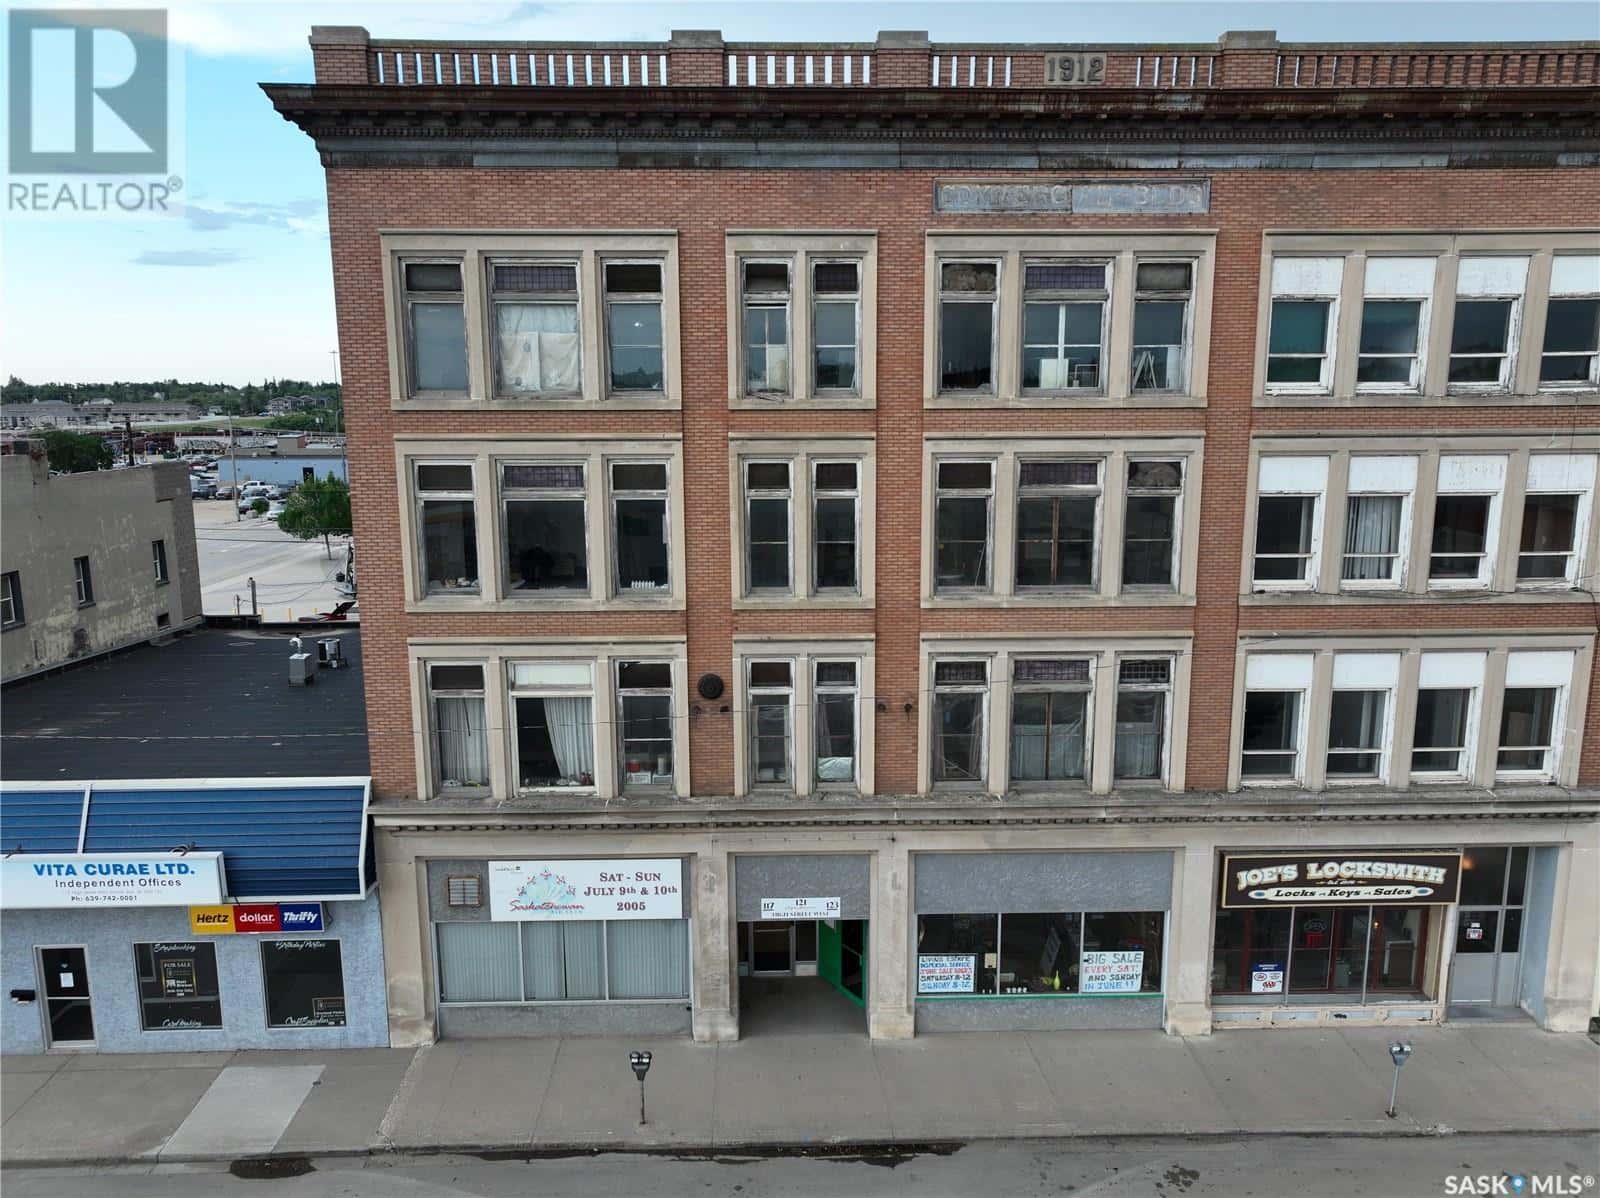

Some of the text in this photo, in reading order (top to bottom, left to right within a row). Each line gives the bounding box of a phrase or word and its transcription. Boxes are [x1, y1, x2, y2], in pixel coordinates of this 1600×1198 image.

[1047, 57, 1104, 82] 1912
[33, 863, 195, 876] VITA CURAE LTD.
[600, 872, 624, 882] SAT
[635, 871, 662, 881] SUN
[1237, 861, 1448, 891] JOE'S LOCKSMITH
[55, 878, 182, 889] Independent Offices
[584, 885, 677, 896] JULY 9th & 10th
[1275, 887, 1412, 897] Locks Keys Sales
[616, 901, 646, 911] 2005
[826, 901, 839, 909] 123
[196, 912, 229, 924] Hertz
[283, 911, 318, 924] Thrifty
[1087, 953, 1143, 964] BIG SALE
[1085, 964, 1112, 973] EVERY
